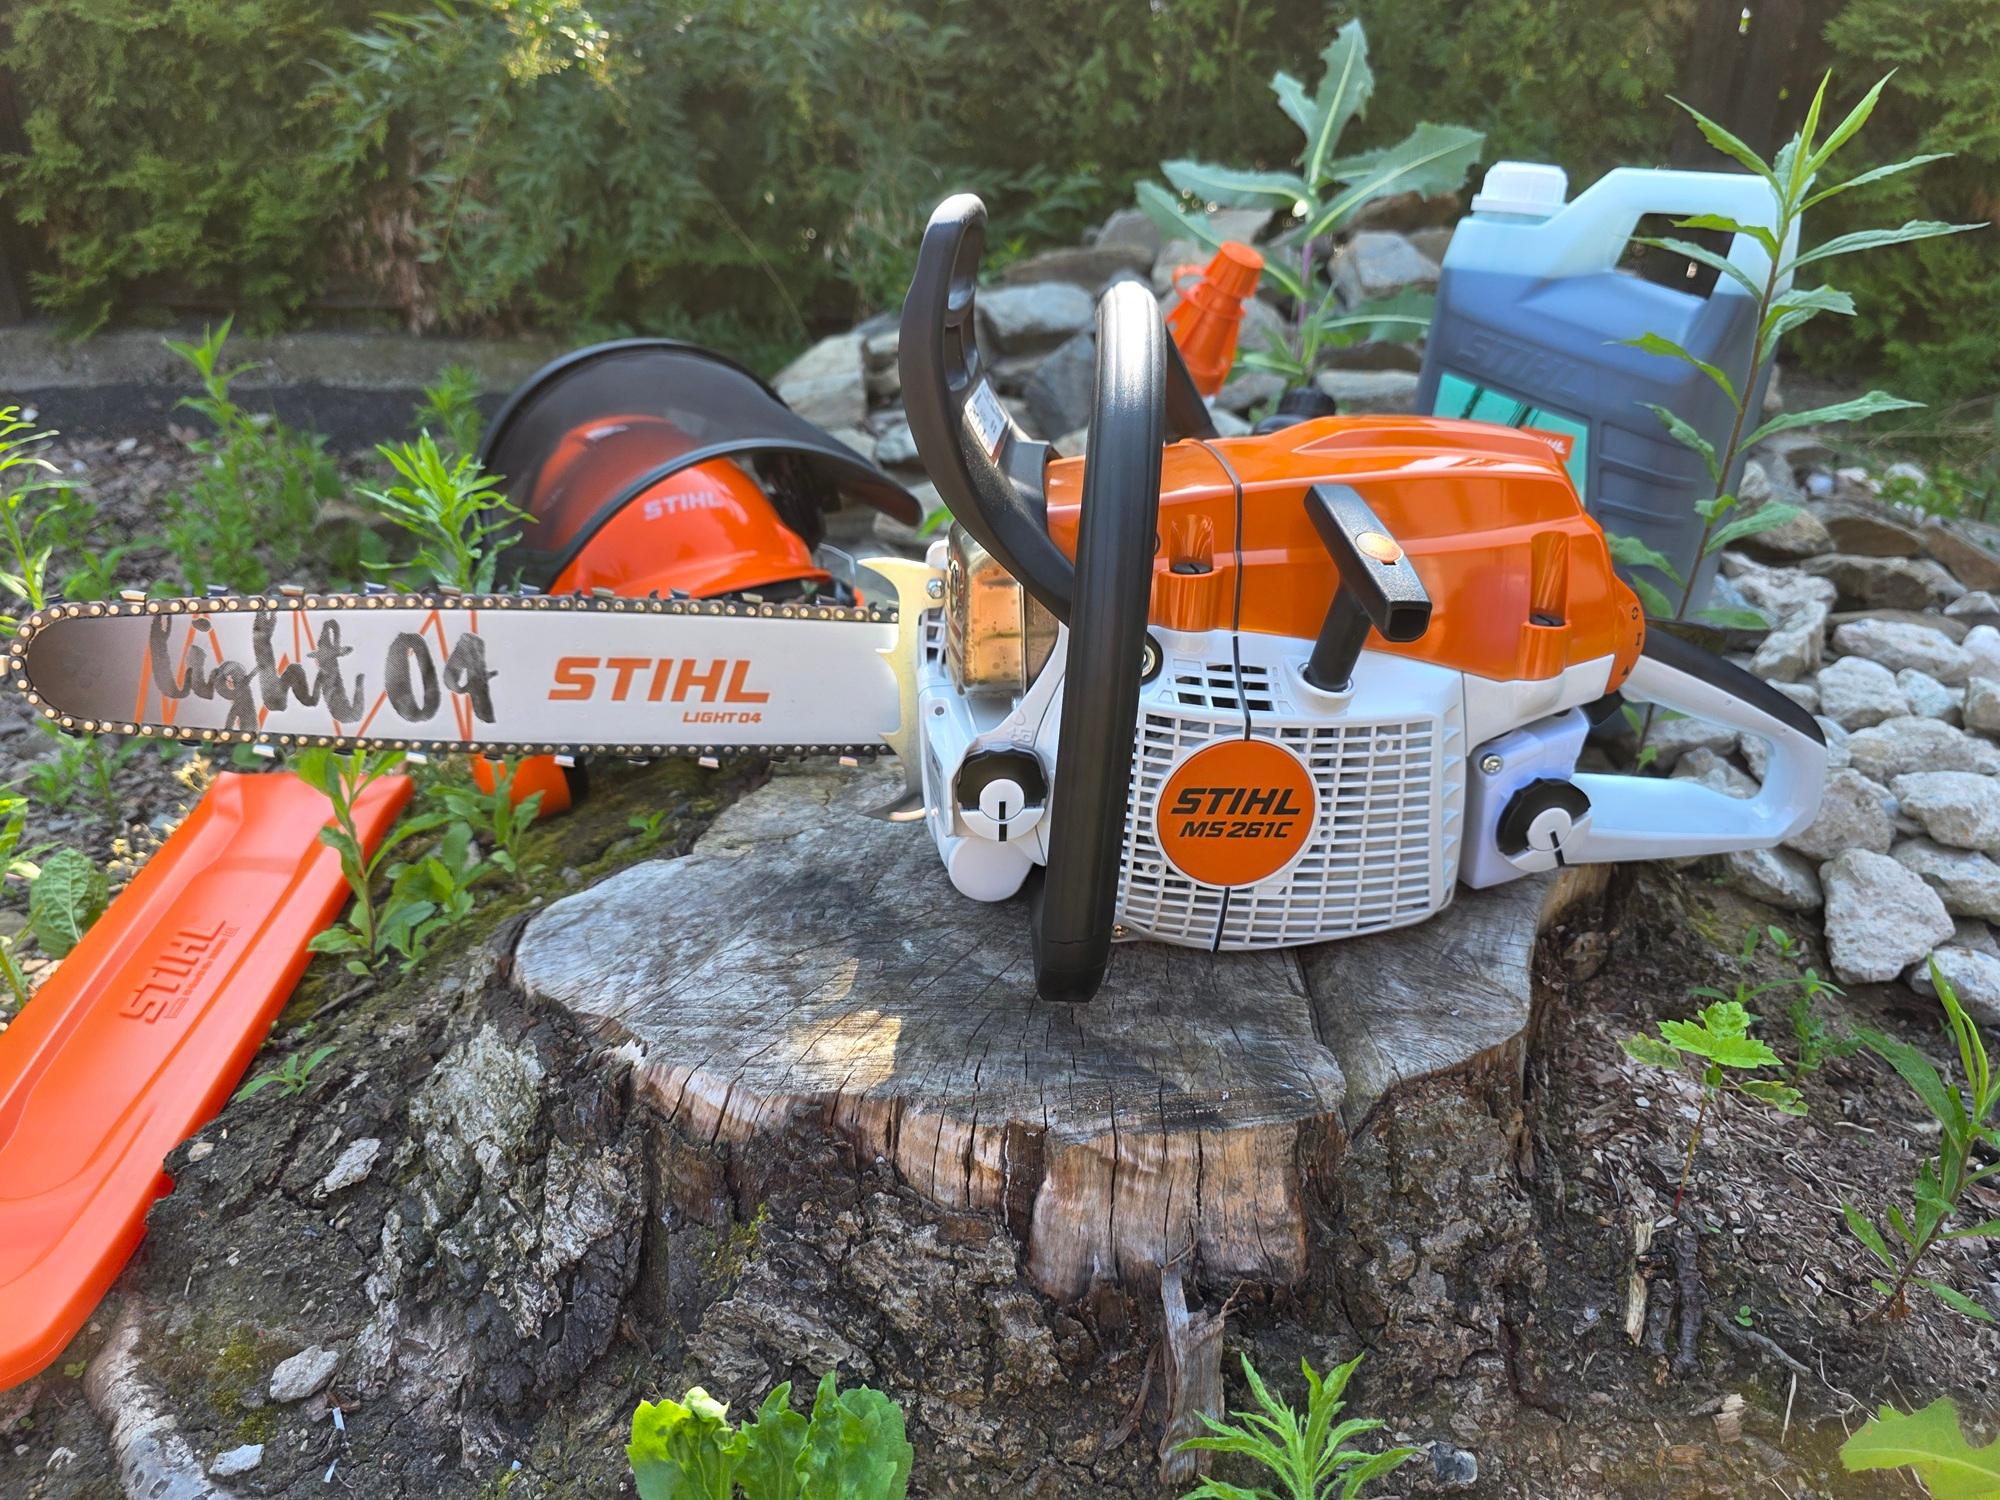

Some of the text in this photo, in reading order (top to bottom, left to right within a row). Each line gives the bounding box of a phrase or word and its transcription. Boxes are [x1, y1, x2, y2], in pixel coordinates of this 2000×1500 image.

[643, 489, 726, 521] STIHL
[547, 656, 770, 703] STIHL
[1170, 787, 1301, 816] STIHL
[1179, 820, 1294, 838] MS 261C
[117, 919, 226, 1025] STIHL
